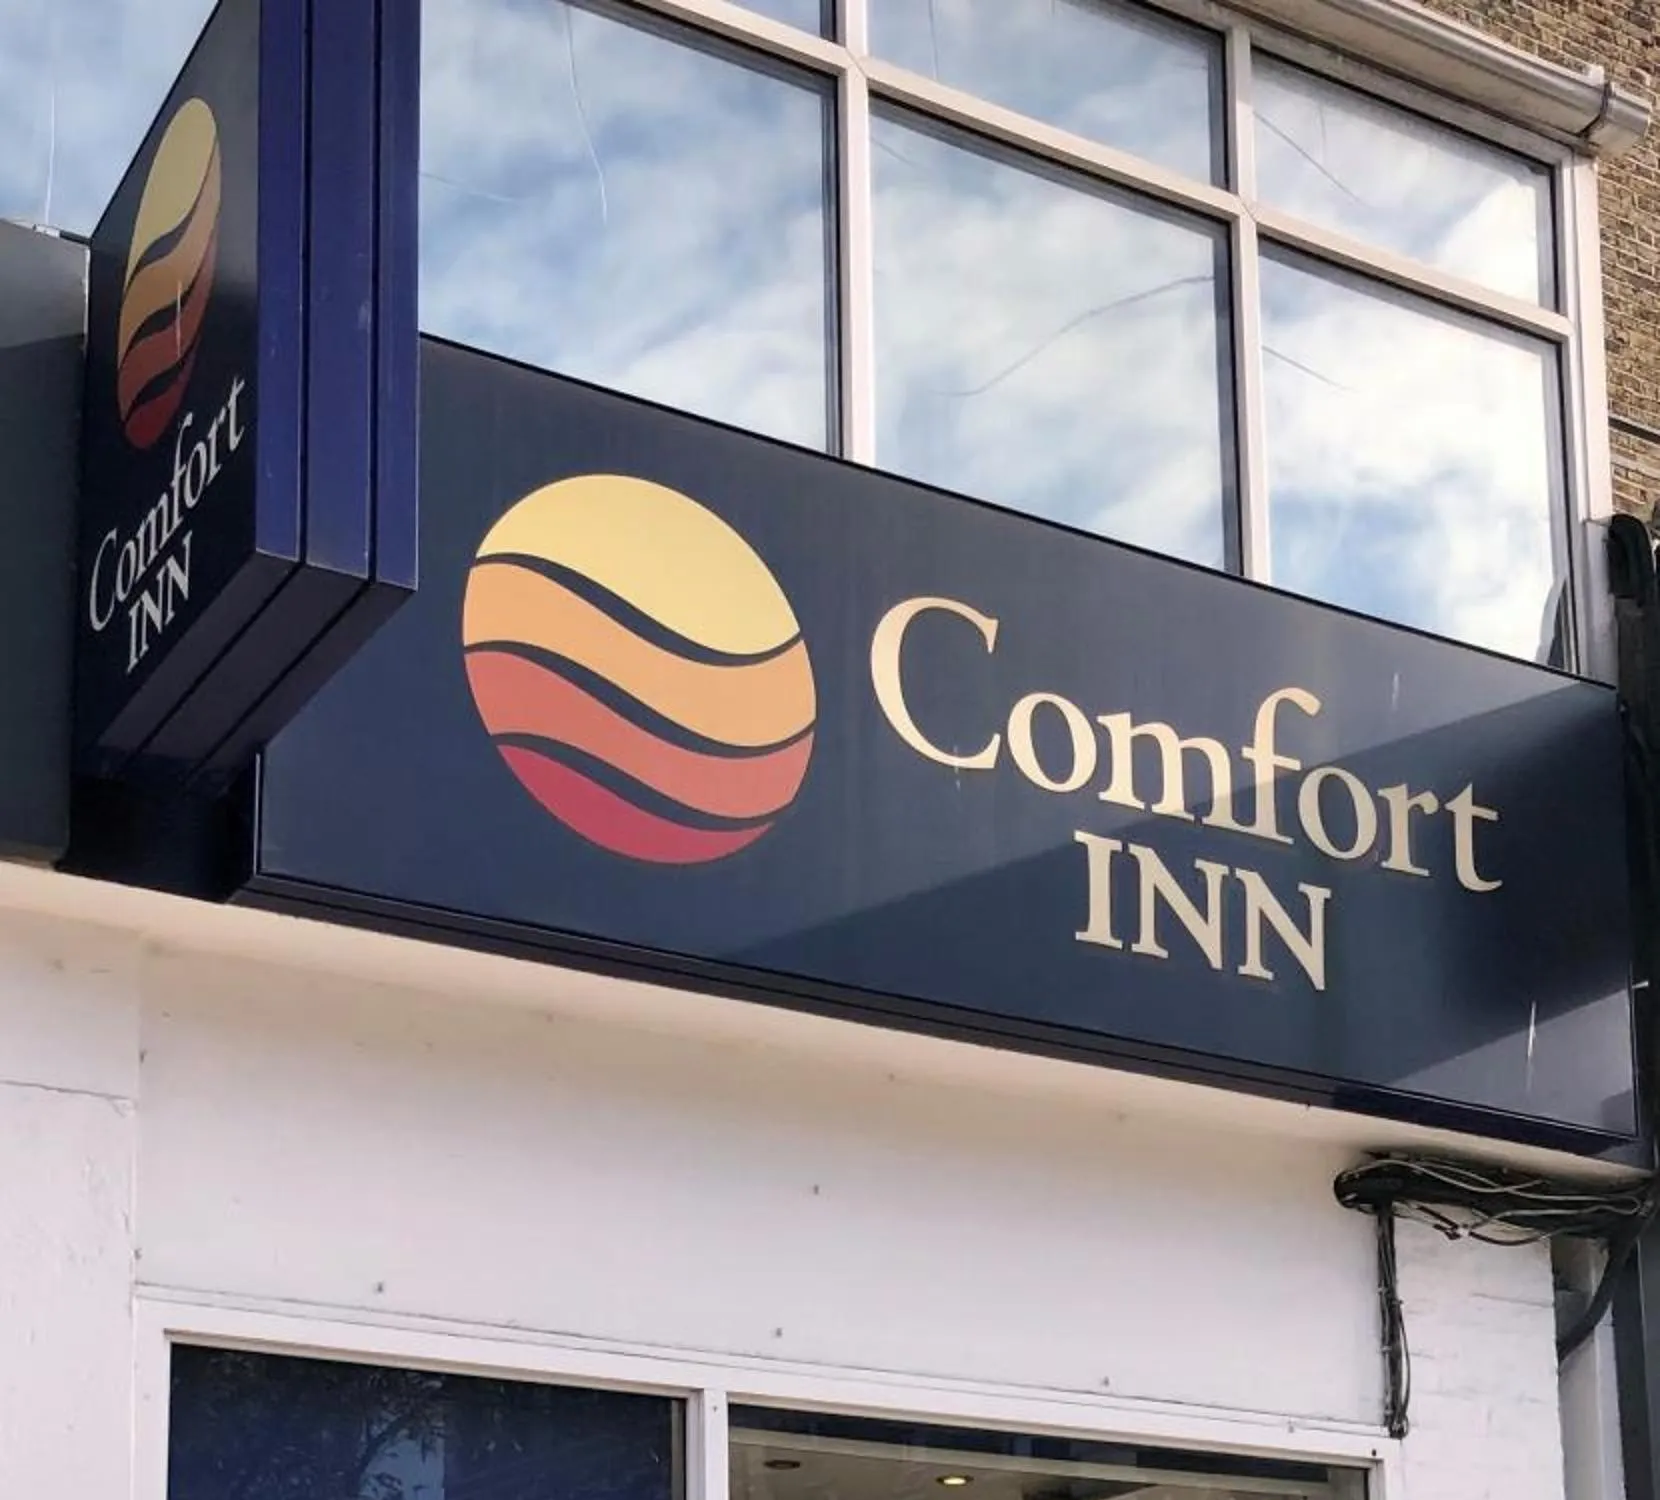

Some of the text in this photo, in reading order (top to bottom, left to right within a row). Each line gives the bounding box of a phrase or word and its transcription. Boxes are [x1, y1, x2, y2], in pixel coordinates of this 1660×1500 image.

[88, 373, 246, 633] Comfort
[125, 529, 194, 677] INN
[869, 596, 1503, 893] Comfort
[1073, 829, 1332, 992] INN
